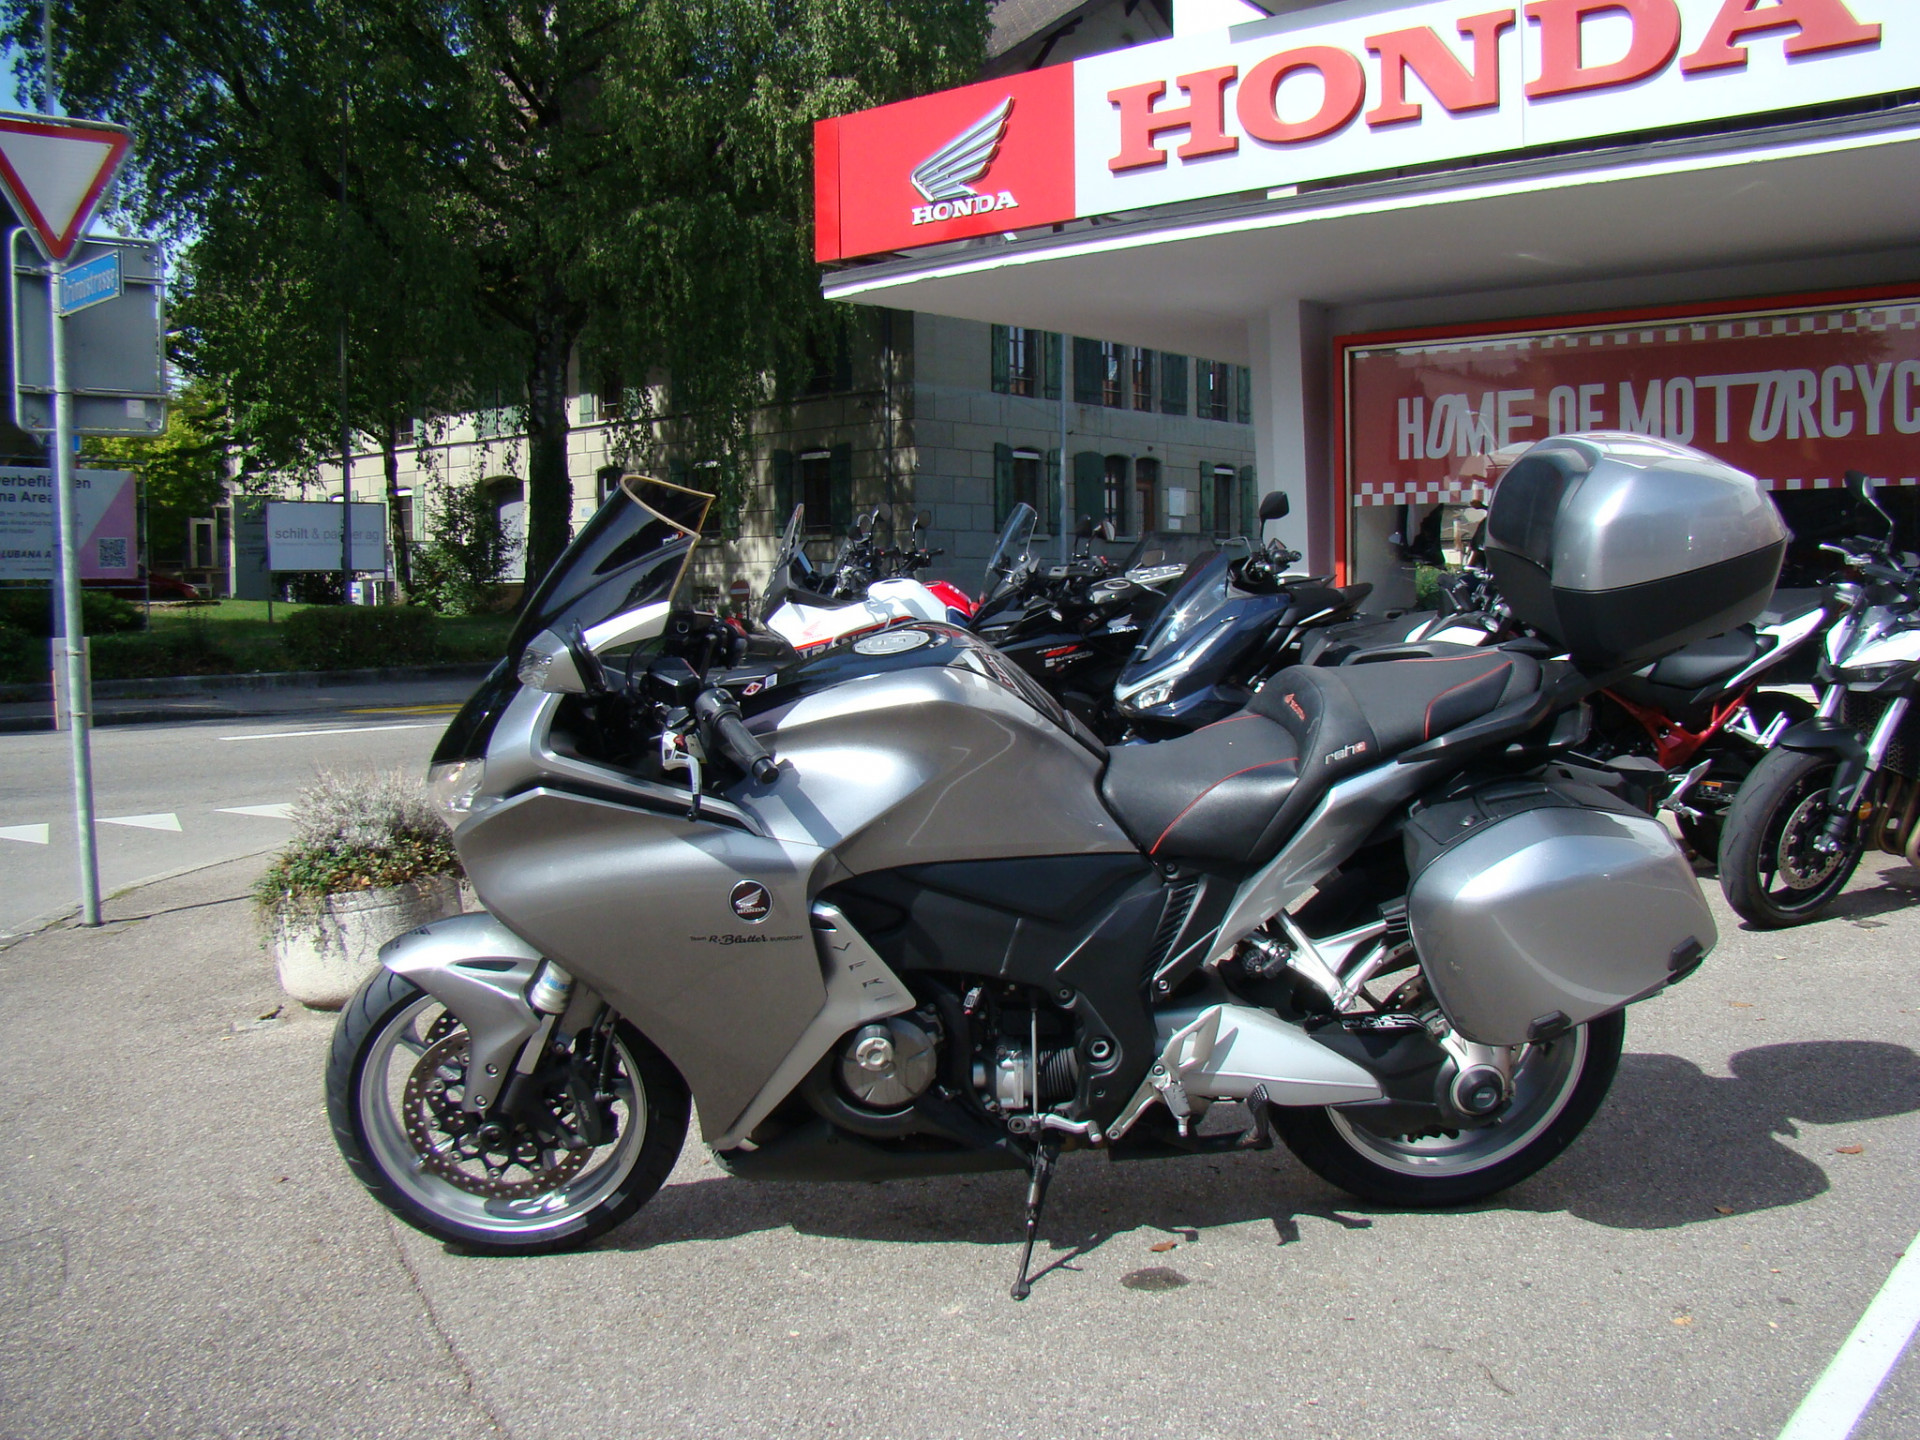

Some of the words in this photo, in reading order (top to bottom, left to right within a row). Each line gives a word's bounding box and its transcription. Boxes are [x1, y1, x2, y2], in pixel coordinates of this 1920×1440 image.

[1107, 0, 1882, 172] HONDA
[911, 190, 1019, 226] HONDA
[1398, 388, 1535, 461] HOME
[1548, 383, 1605, 438] OF
[21, 491, 52, 503] Area
[275, 528, 309, 540] schilt
[311, 528, 320, 540] &
[365, 530, 380, 542] ag
[2, 549, 41, 559] LUBANA
[737, 906, 768, 915] HONDA
